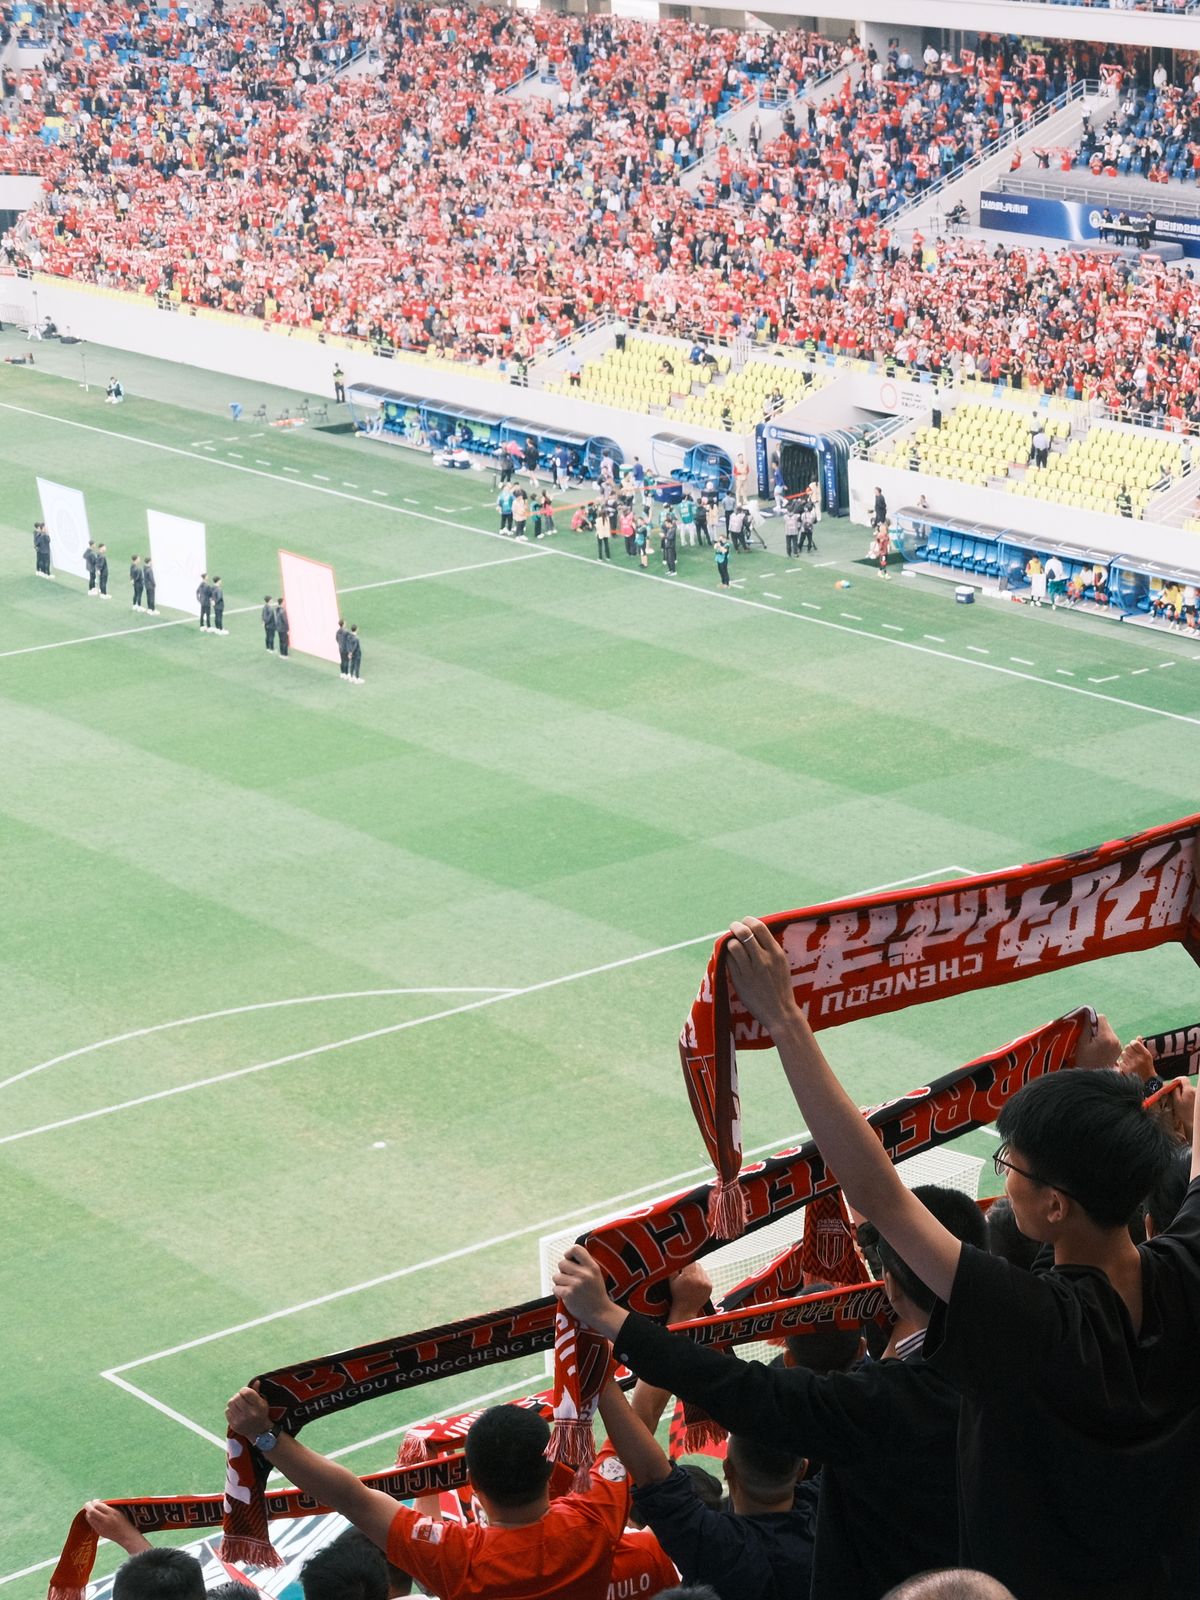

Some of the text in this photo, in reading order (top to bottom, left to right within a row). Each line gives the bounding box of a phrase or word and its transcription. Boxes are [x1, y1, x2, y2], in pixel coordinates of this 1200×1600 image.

[825, 951, 983, 1014] CHENGDU
[294, 1377, 389, 1418] CHENGDU
[396, 1341, 524, 1384] RONGCHENG
